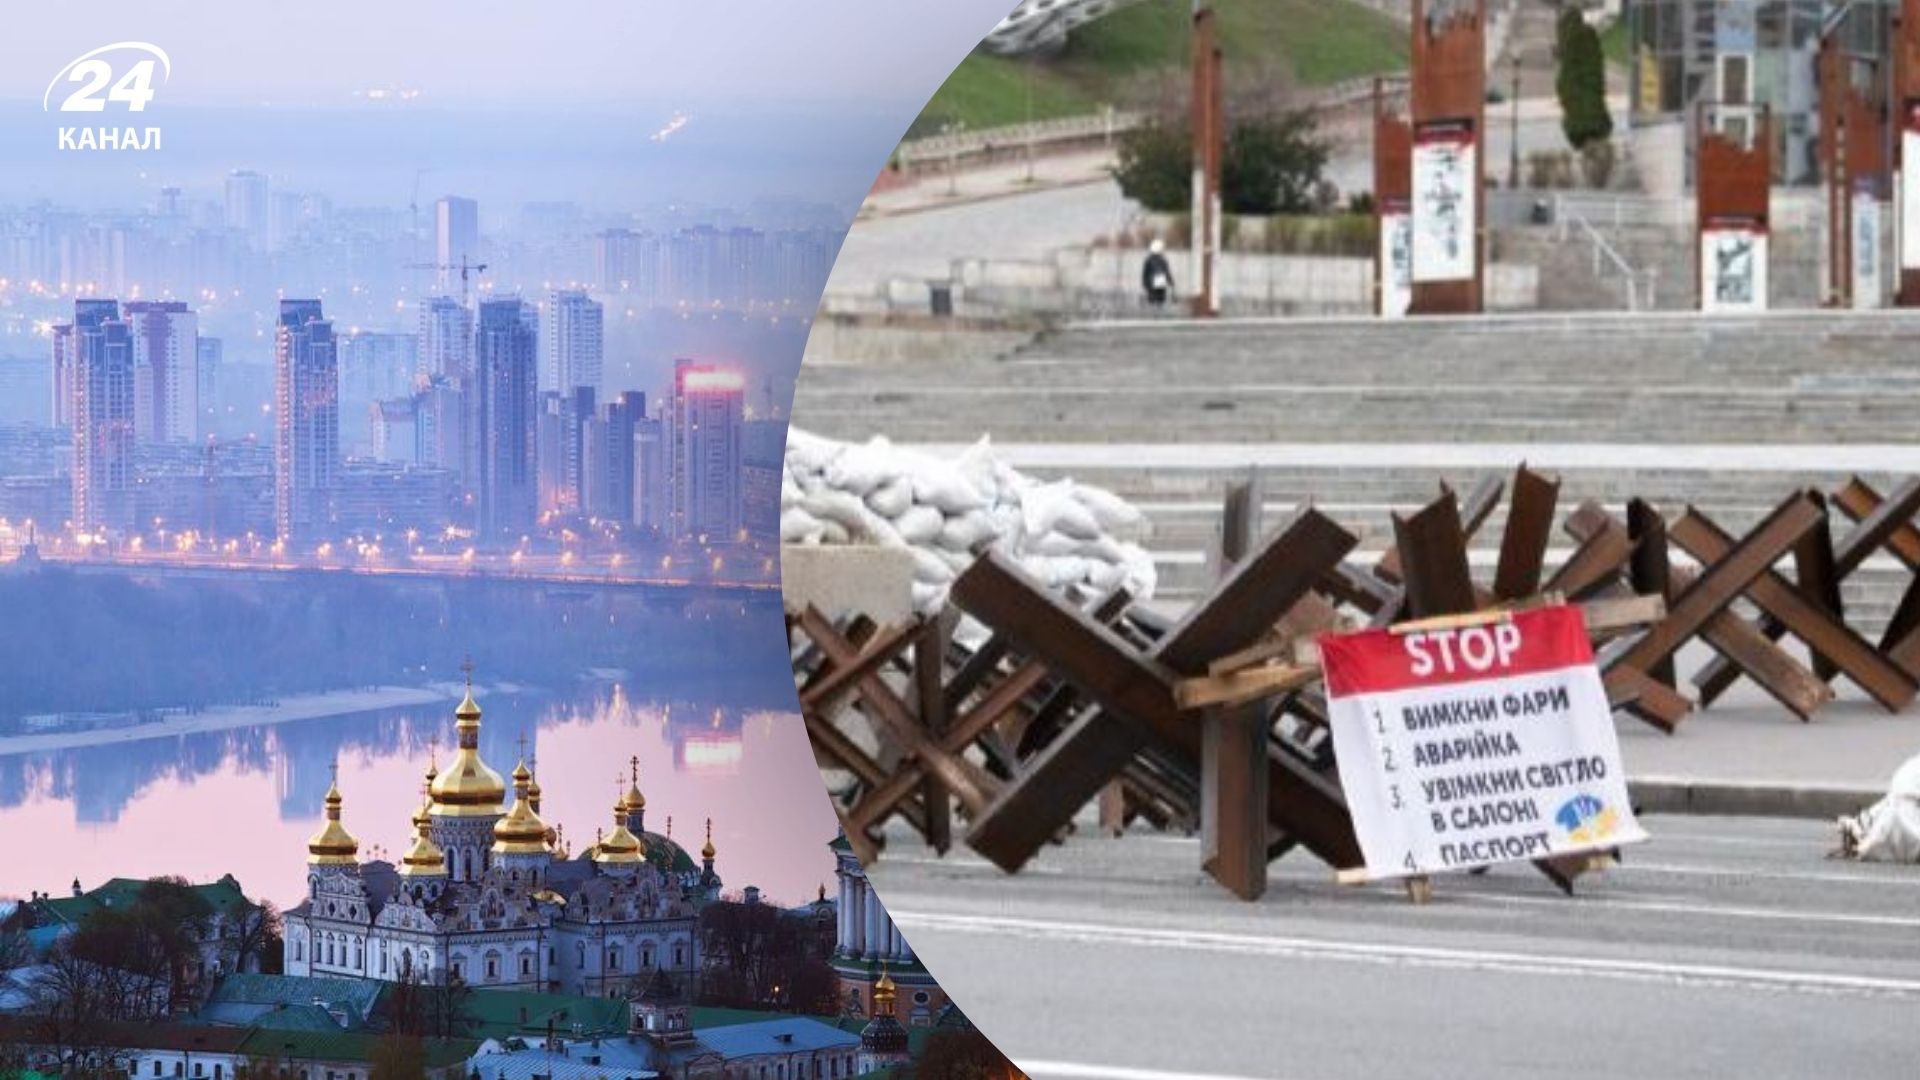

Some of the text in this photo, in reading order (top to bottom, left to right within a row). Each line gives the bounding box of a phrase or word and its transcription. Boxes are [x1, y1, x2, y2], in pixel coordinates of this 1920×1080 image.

[1405, 624, 1521, 675] STOP
[1402, 697, 1497, 731] ВИМКНИ
[1503, 686, 1570, 717] ФАРИ
[1413, 731, 1520, 767] АВАРІЙКА
[1421, 773, 1524, 803] УВІМКНИ
[1526, 756, 1606, 789] СВІТЛО
[1432, 800, 1540, 833] В САЛОНІ
[1439, 833, 1550, 865] ПАСПОРТ
